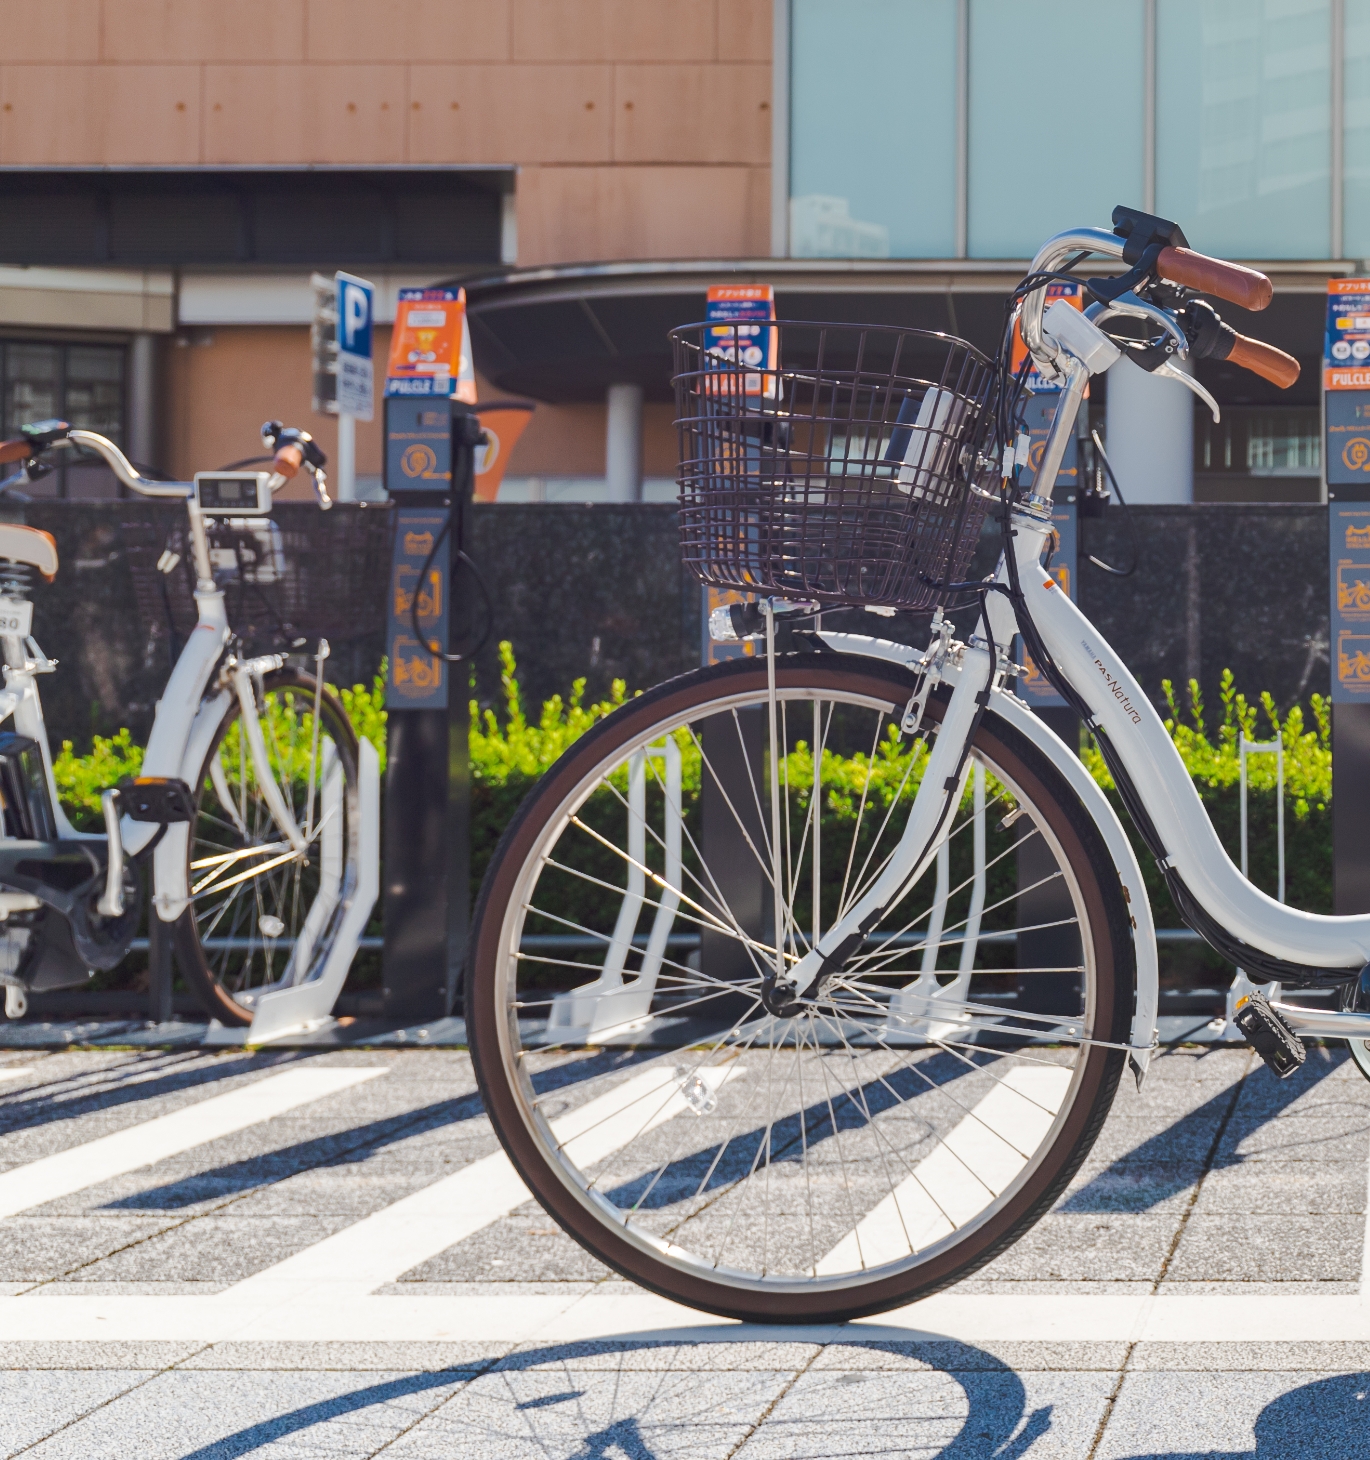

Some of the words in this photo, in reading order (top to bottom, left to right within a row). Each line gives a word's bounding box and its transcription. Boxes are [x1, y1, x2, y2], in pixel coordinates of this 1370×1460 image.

[345, 283, 369, 350] P
[1094, 659, 1113, 682] PAS
[1107, 680, 1141, 725] Natura
